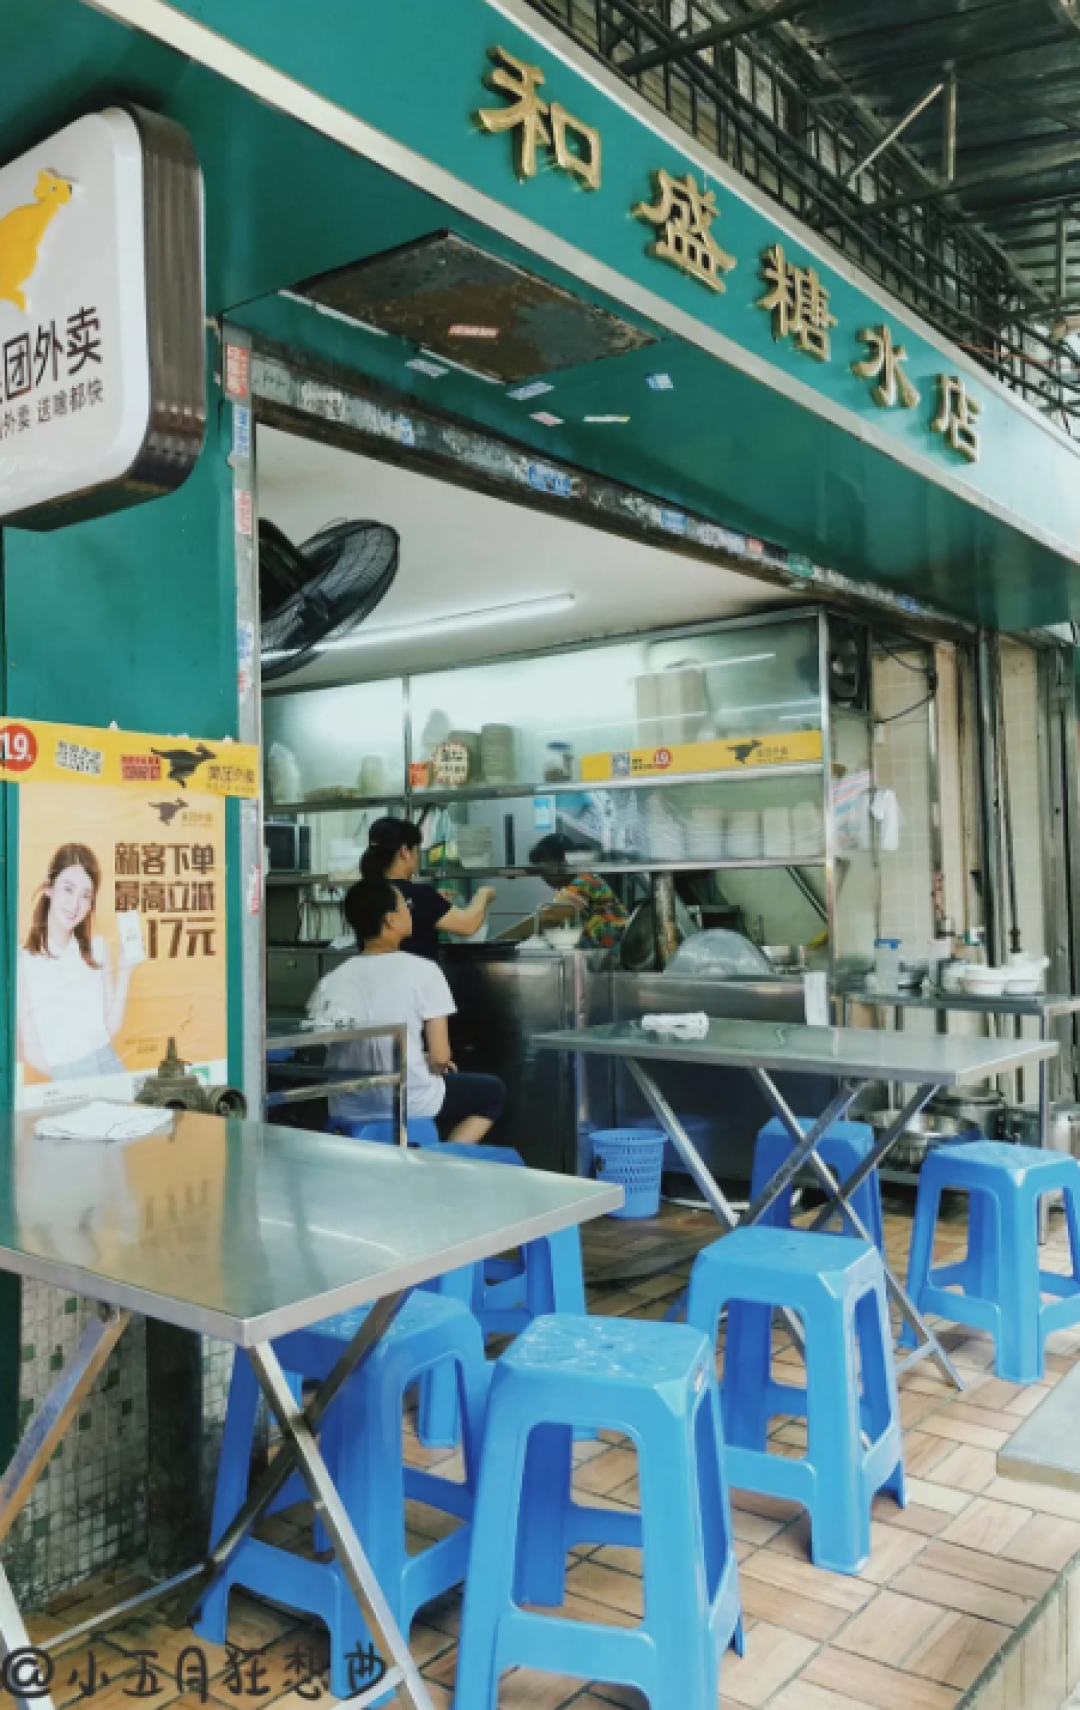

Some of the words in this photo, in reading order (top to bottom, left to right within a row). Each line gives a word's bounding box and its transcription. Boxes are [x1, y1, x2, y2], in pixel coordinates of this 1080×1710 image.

[476, 45, 982, 462] 和盛糖水店
[0, 306, 103, 405] 团外卖
[114, 842, 216, 875] 新客下单
[114, 881, 215, 913] 最高立减
[146, 917, 216, 960] 17元
